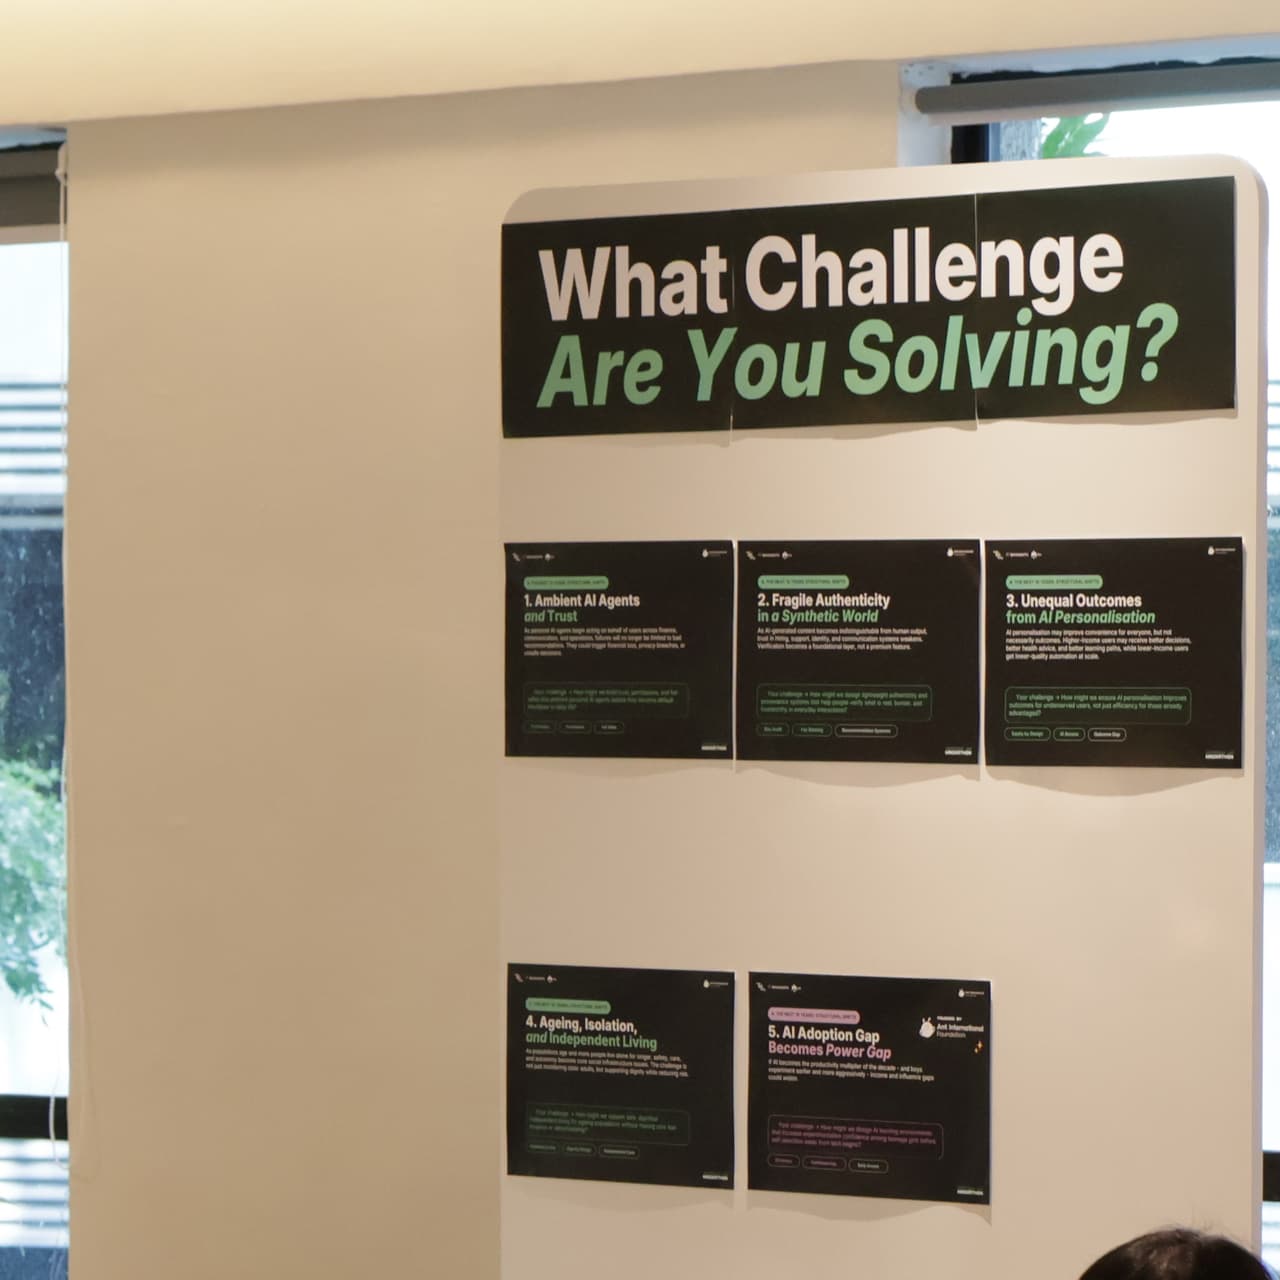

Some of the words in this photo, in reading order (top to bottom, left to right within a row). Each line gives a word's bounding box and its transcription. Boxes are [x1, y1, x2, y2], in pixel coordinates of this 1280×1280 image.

[538, 245, 728, 320] What
[746, 227, 1123, 316] Challenge
[537, 335, 662, 407] Are
[687, 327, 826, 400] You
[844, 302, 1178, 405] Solving?
[523, 592, 533, 607] 1.
[533, 592, 583, 607] Ambient
[583, 592, 597, 607] AI
[597, 592, 641, 610] Agents
[757, 592, 770, 607] 2.
[771, 592, 814, 609] Fragile
[814, 592, 891, 610] Authenticity
[1005, 592, 1019, 608] 3.
[1020, 592, 1074, 611] Unequal
[1074, 592, 1142, 608] Outcomes
[523, 609, 546, 623] and
[546, 609, 578, 623] Trust
[756, 608, 769, 623] in
[770, 611, 780, 623] a
[780, 608, 840, 625] Synthetic
[841, 608, 879, 623] World
[1005, 609, 1037, 624] from
[1037, 609, 1053, 624] AI
[1053, 609, 1156, 624] Personalisation
[524, 1014, 537, 1028] 4.
[538, 1015, 583, 1033] Ageing,
[583, 1016, 638, 1036] Isolation,
[767, 1024, 780, 1039] 5.
[781, 1025, 796, 1039] AI
[796, 1025, 853, 1043] Adoption
[854, 1028, 880, 1046] Gap
[525, 1031, 548, 1044] and
[548, 1031, 621, 1048] Independent
[621, 1033, 658, 1052] Living
[767, 1039, 824, 1056] Becomes
[824, 1042, 865, 1058] Power
[865, 1043, 892, 1062] Gap
